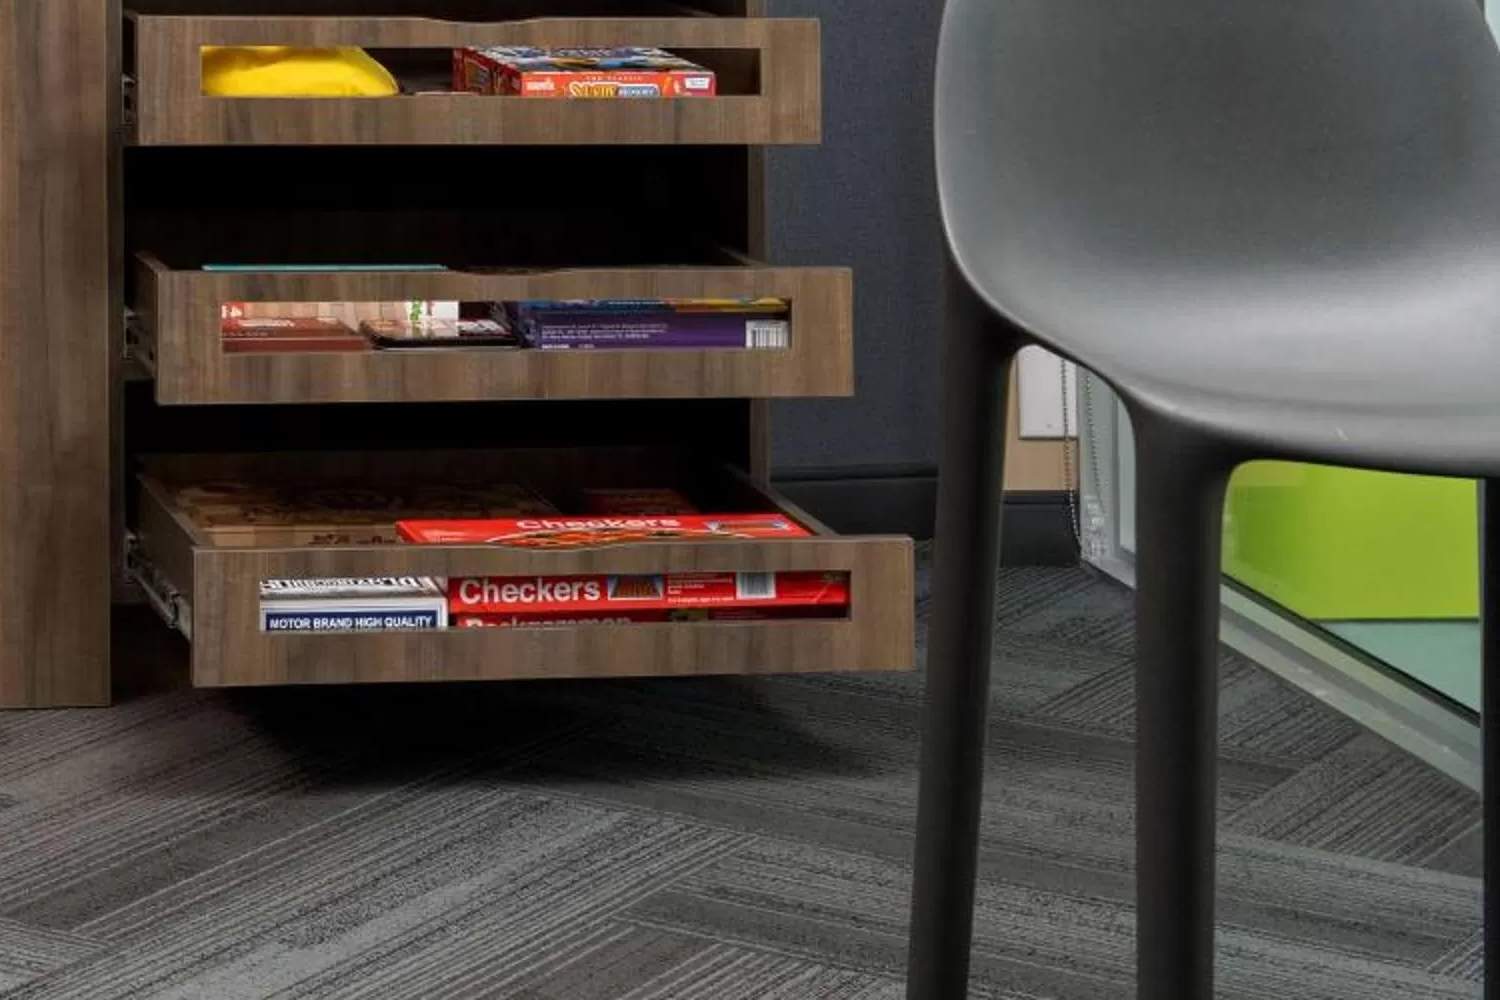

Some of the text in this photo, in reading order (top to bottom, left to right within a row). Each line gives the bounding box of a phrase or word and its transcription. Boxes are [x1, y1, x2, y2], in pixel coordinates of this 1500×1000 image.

[516, 519, 681, 530] Checkers
[460, 577, 601, 604] Checkers
[269, 615, 432, 630] MOTOR BRAND HIGH QUALITY
